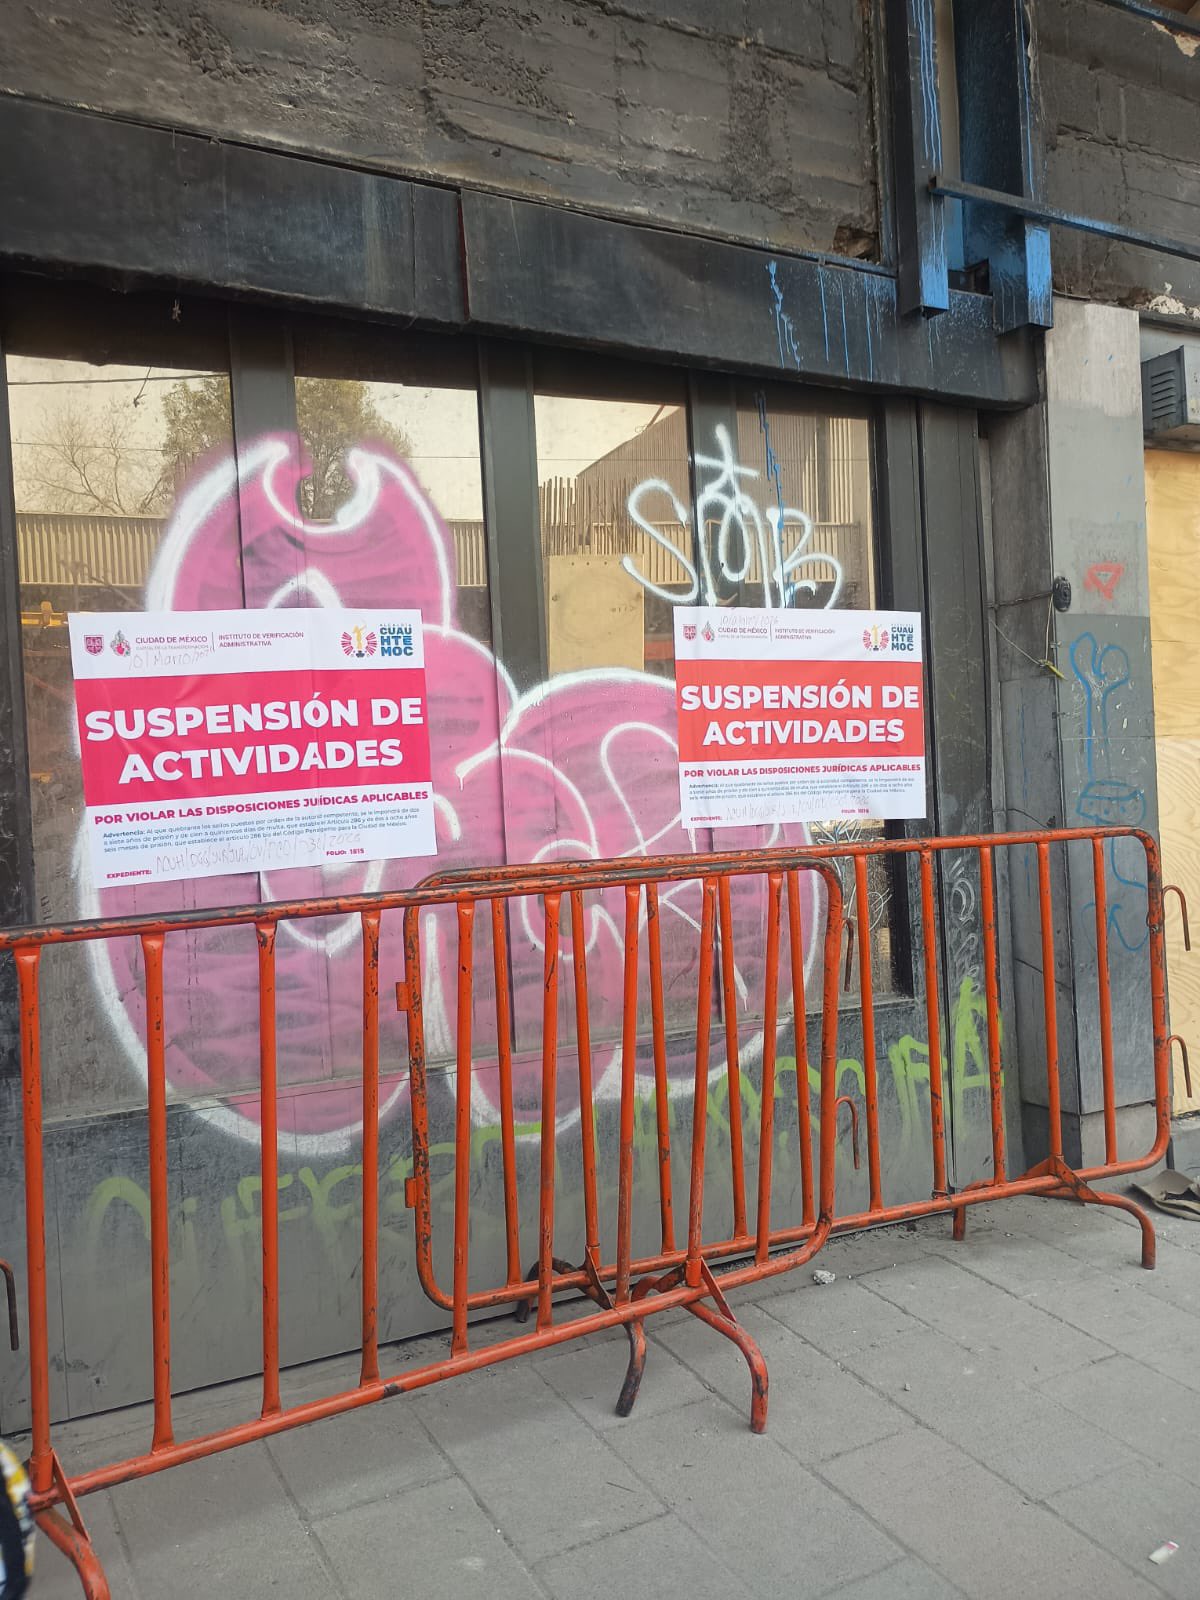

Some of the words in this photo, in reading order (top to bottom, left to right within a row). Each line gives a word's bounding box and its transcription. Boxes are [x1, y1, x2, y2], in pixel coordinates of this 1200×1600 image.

[219, 632, 251, 640] INSTITUTO
[262, 631, 304, 639] VERIFICACIÓN
[380, 627, 412, 635] CUAU
[135, 636, 165, 644] CIUDAD
[179, 634, 208, 643] MÉXICO
[380, 636, 412, 645] HTE
[891, 634, 913, 642] HTE
[219, 640, 272, 648] ADMINISTRATIVA
[891, 643, 914, 651] MOC
[381, 646, 414, 657] MOC
[681, 679, 872, 710] SUSPENSIÓN
[881, 685, 920, 708] DE
[84, 692, 359, 741] SUSPENSIÓN
[371, 697, 424, 726] DE
[702, 719, 905, 746] ACTIVIDADES
[118, 739, 404, 785] ACTIVIDADES
[707, 768, 739, 776] VIOLAR
[760, 766, 820, 775] DISPOSICIONES
[822, 764, 867, 773] JURÍDICAS
[869, 764, 920, 772] APLICABLES
[95, 815, 123, 825] POR
[127, 809, 175, 822] VIOLAR
[179, 806, 203, 818] LAS
[206, 799, 300, 816] DISPOSICIONES
[303, 795, 358, 807] JUÍDICAS
[361, 791, 428, 803] APLICABLES
[106, 869, 152, 879] EXPEDIENTE:
